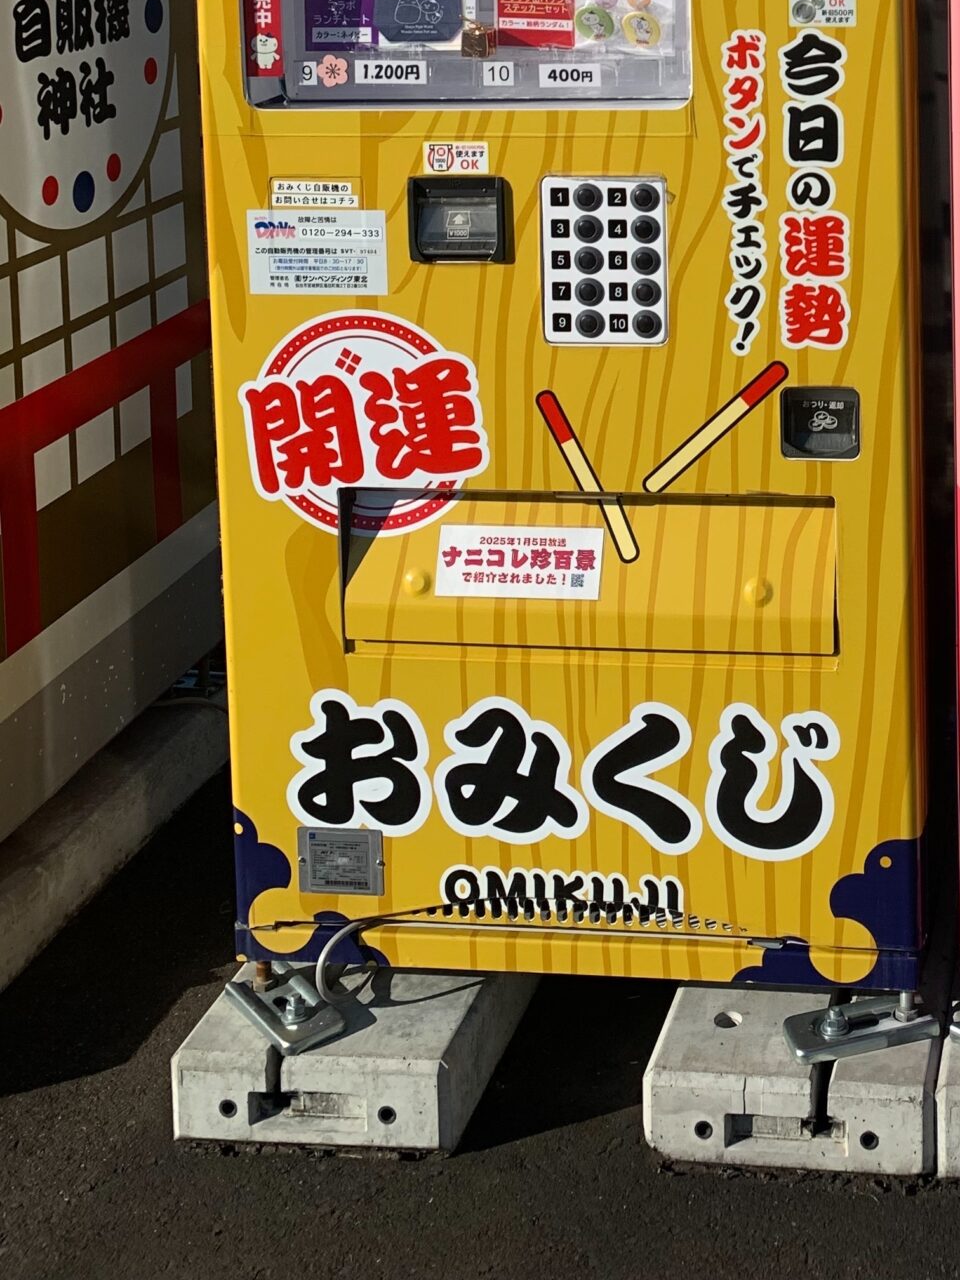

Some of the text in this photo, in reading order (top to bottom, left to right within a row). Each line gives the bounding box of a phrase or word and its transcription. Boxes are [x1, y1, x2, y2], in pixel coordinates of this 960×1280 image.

[303, 66, 312, 80] 9
[488, 66, 510, 81] 10
[548, 69, 593, 83] 400円
[37, 57, 116, 140] 神社
[461, 160, 479, 169] OK
[278, 184, 348, 192] おみくじ自販機の
[784, 34, 845, 345] 今日の運勢
[275, 196, 354, 205] お問い合せはコチラ
[556, 192, 562, 202] 1
[614, 192, 621, 202] 2
[255, 222, 296, 239] DRINK
[557, 224, 564, 233] 3
[614, 225, 621, 234] 4
[558, 256, 564, 265] 5
[615, 256, 622, 265] 6
[559, 287, 565, 296] 7
[615, 287, 622, 296] 8
[559, 318, 565, 327] 9
[613, 319, 625, 329] 10
[245, 358, 482, 493] 開運
[479, 536, 567, 548] 2025年1月5日放送
[442, 547, 596, 570] ナニコレ珍百景
[298, 700, 829, 849] おみくじ
[444, 869, 681, 917] OMIKUJI
